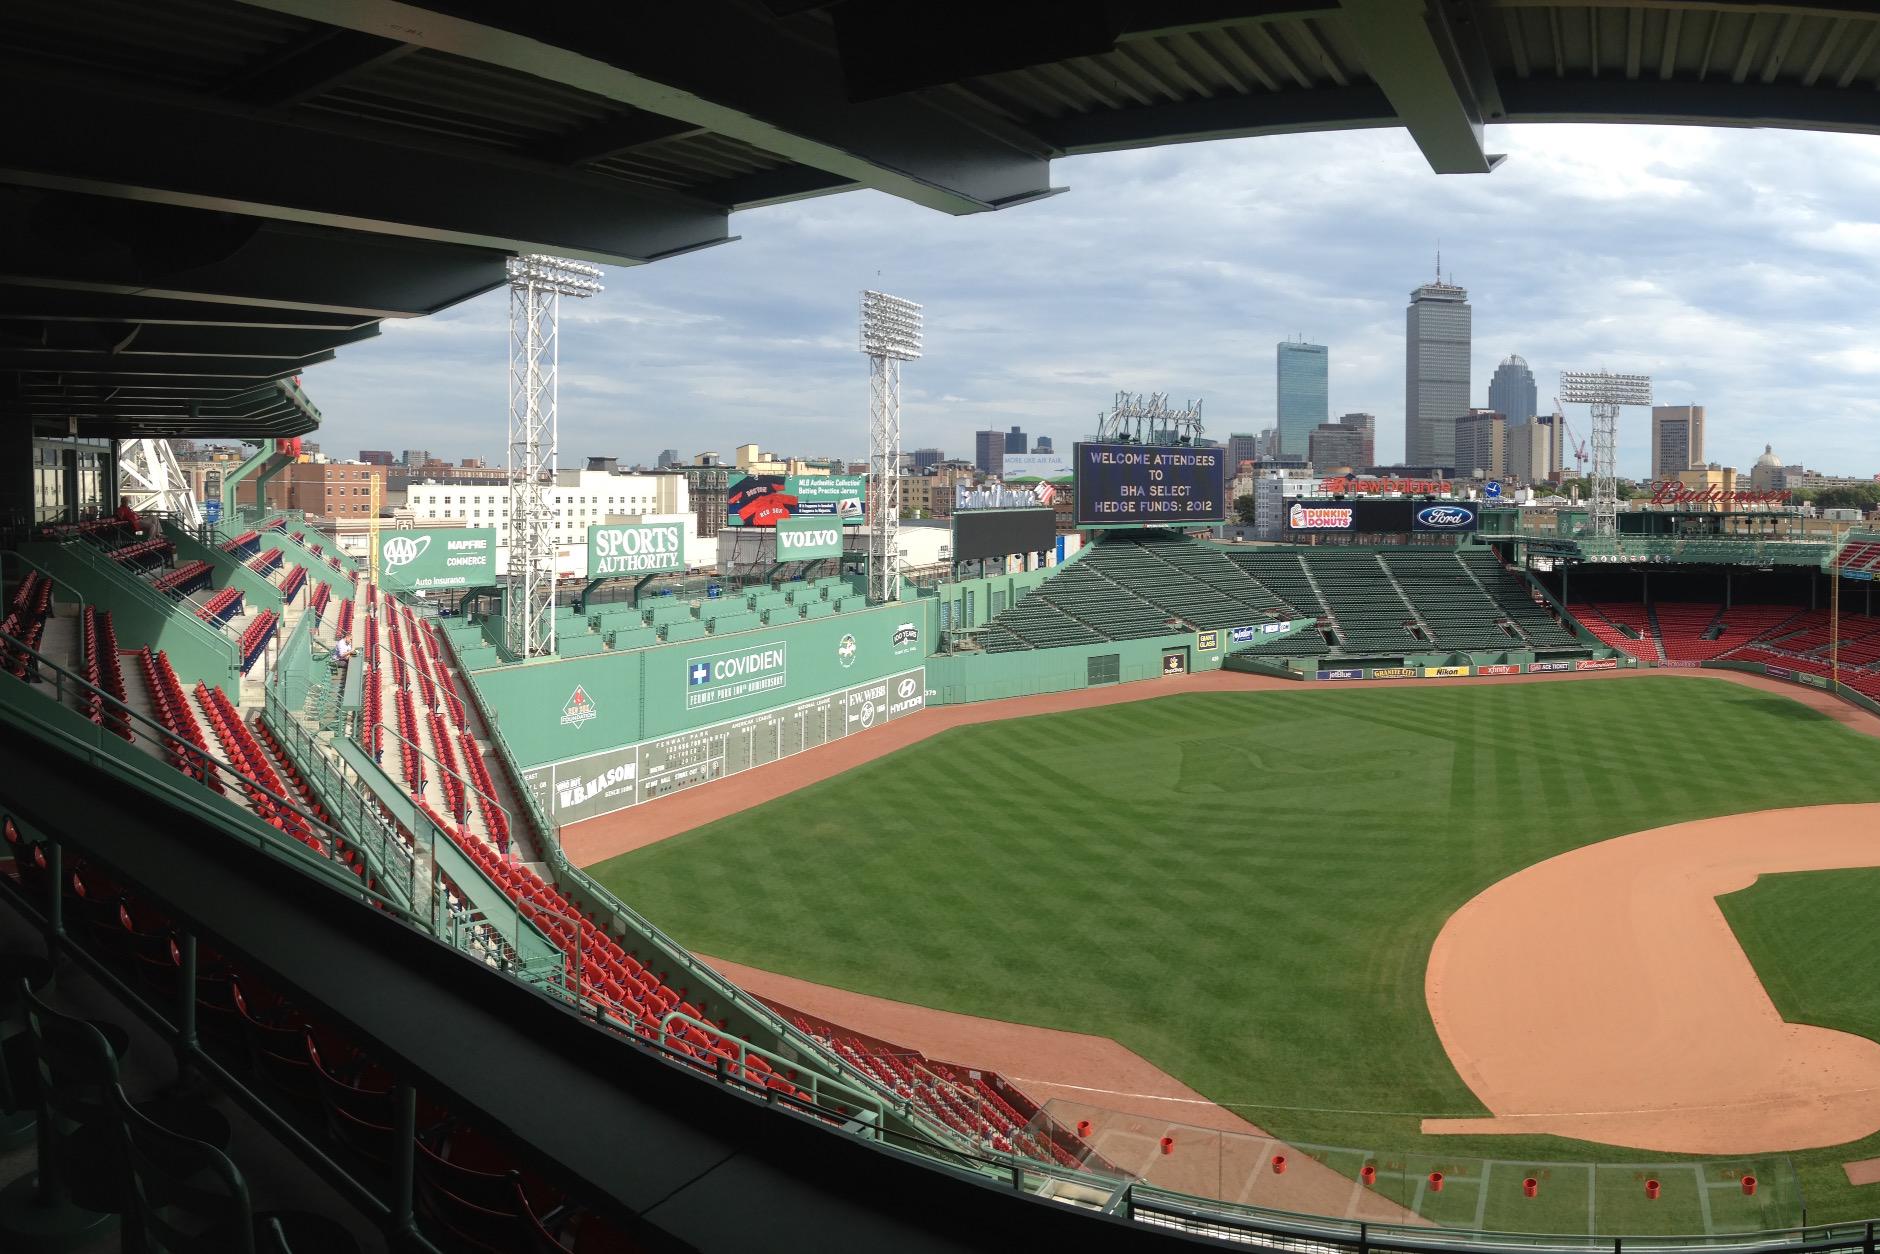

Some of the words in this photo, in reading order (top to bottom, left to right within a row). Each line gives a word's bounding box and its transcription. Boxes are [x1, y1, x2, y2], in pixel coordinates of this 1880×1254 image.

[1091, 452, 1150, 465] WELCOME
[1154, 453, 1215, 466] ATTENDEES
[1149, 469, 1163, 481] TO
[1120, 485, 1145, 497] BHA
[1149, 485, 1191, 497] SELECT
[1350, 480, 1380, 493] new
[1384, 477, 1451, 494] balance
[1651, 480, 1792, 504] Budweiser
[1095, 501, 1136, 513] HEDGE
[1140, 501, 1182, 512] FUNDS:
[1186, 501, 1212, 511] 2012
[1308, 509, 1351, 518] DUNKIN'
[1429, 509, 1462, 524] Ford
[1308, 518, 1348, 528] DONUTS
[448, 540, 486, 549] MAPFRE
[596, 527, 678, 556] SPORTS
[780, 530, 837, 548] VOLVO
[447, 556, 486, 566] COMMERCE
[416, 578, 432, 586] Auto
[434, 576, 465, 585] Insurance
[903, 630, 917, 639] YEARS
[714, 649, 783, 680] COVIDIEN
[1487, 666, 1511, 674] xfinity
[1329, 671, 1352, 679] jetBlue
[890, 696, 922, 713] HYUNDAI
